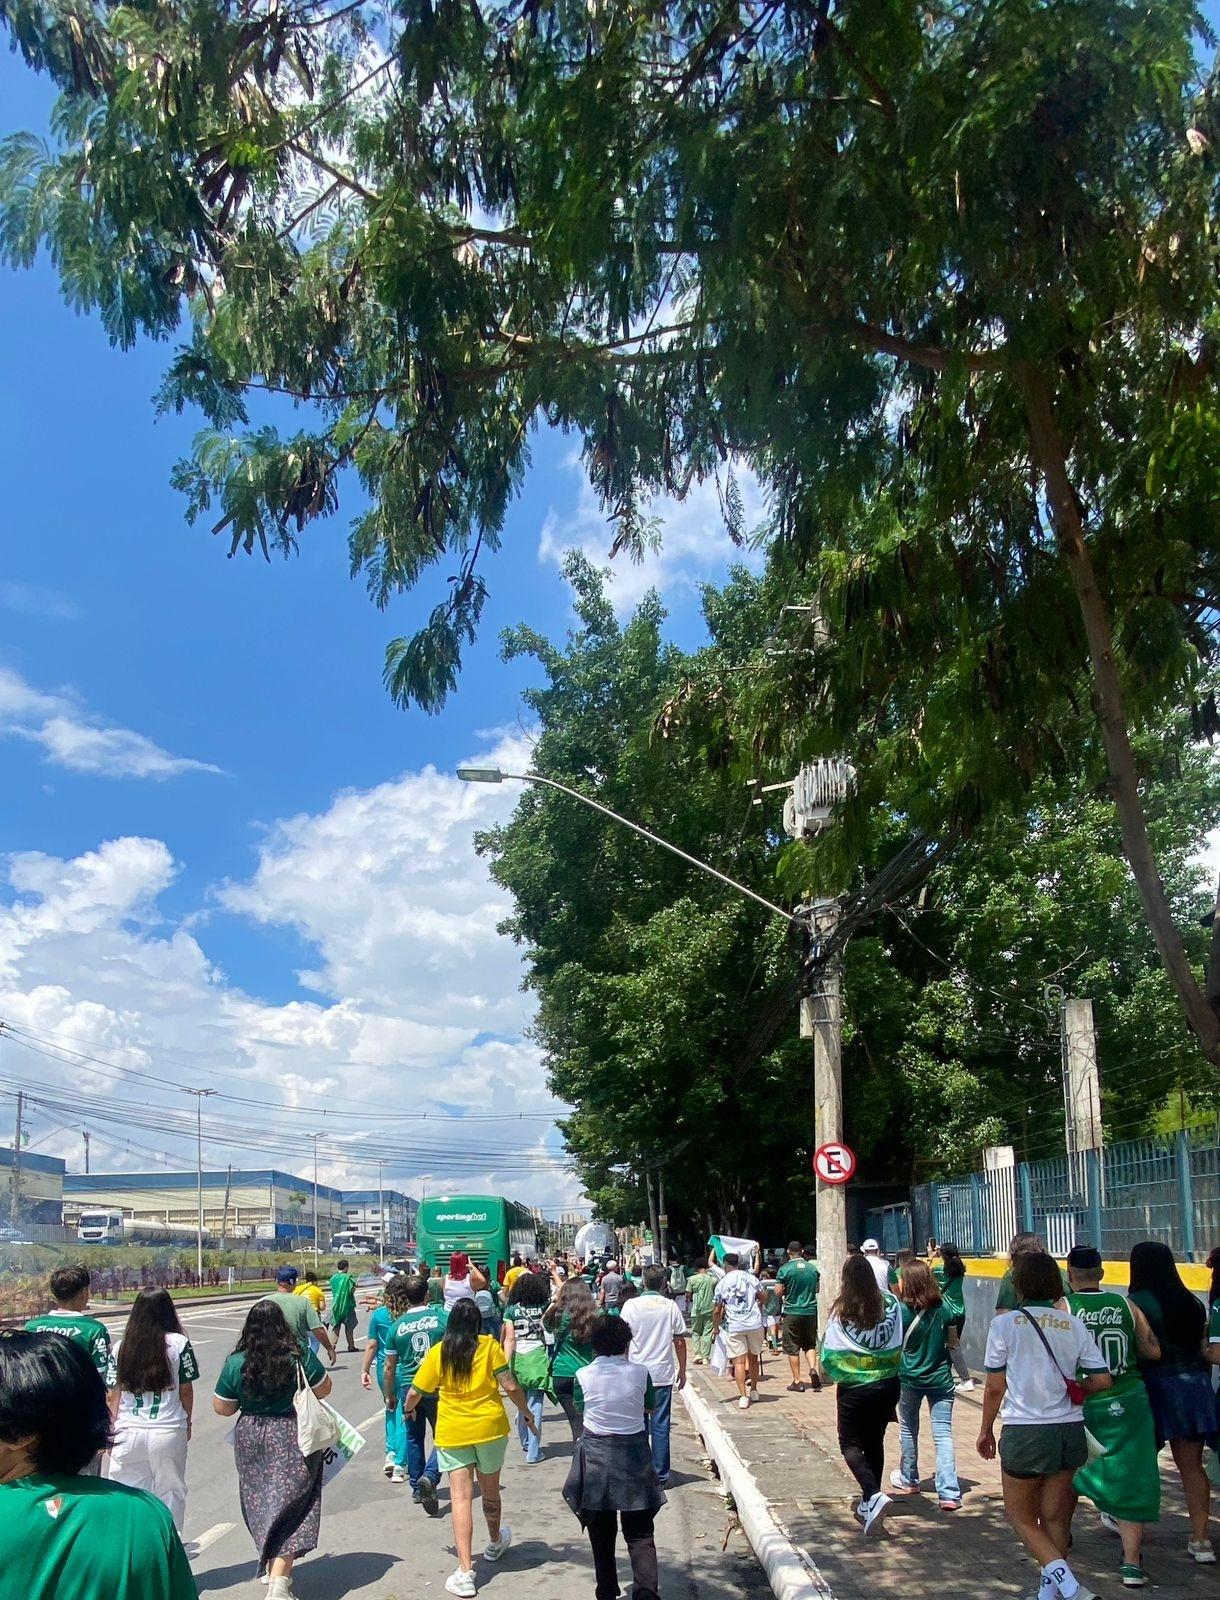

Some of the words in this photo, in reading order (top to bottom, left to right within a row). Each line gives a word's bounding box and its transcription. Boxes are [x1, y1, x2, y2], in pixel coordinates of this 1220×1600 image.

[827, 1151, 842, 1174] E
[436, 1213, 487, 1222] sportingbet
[1014, 1313, 1072, 1330] crfisa
